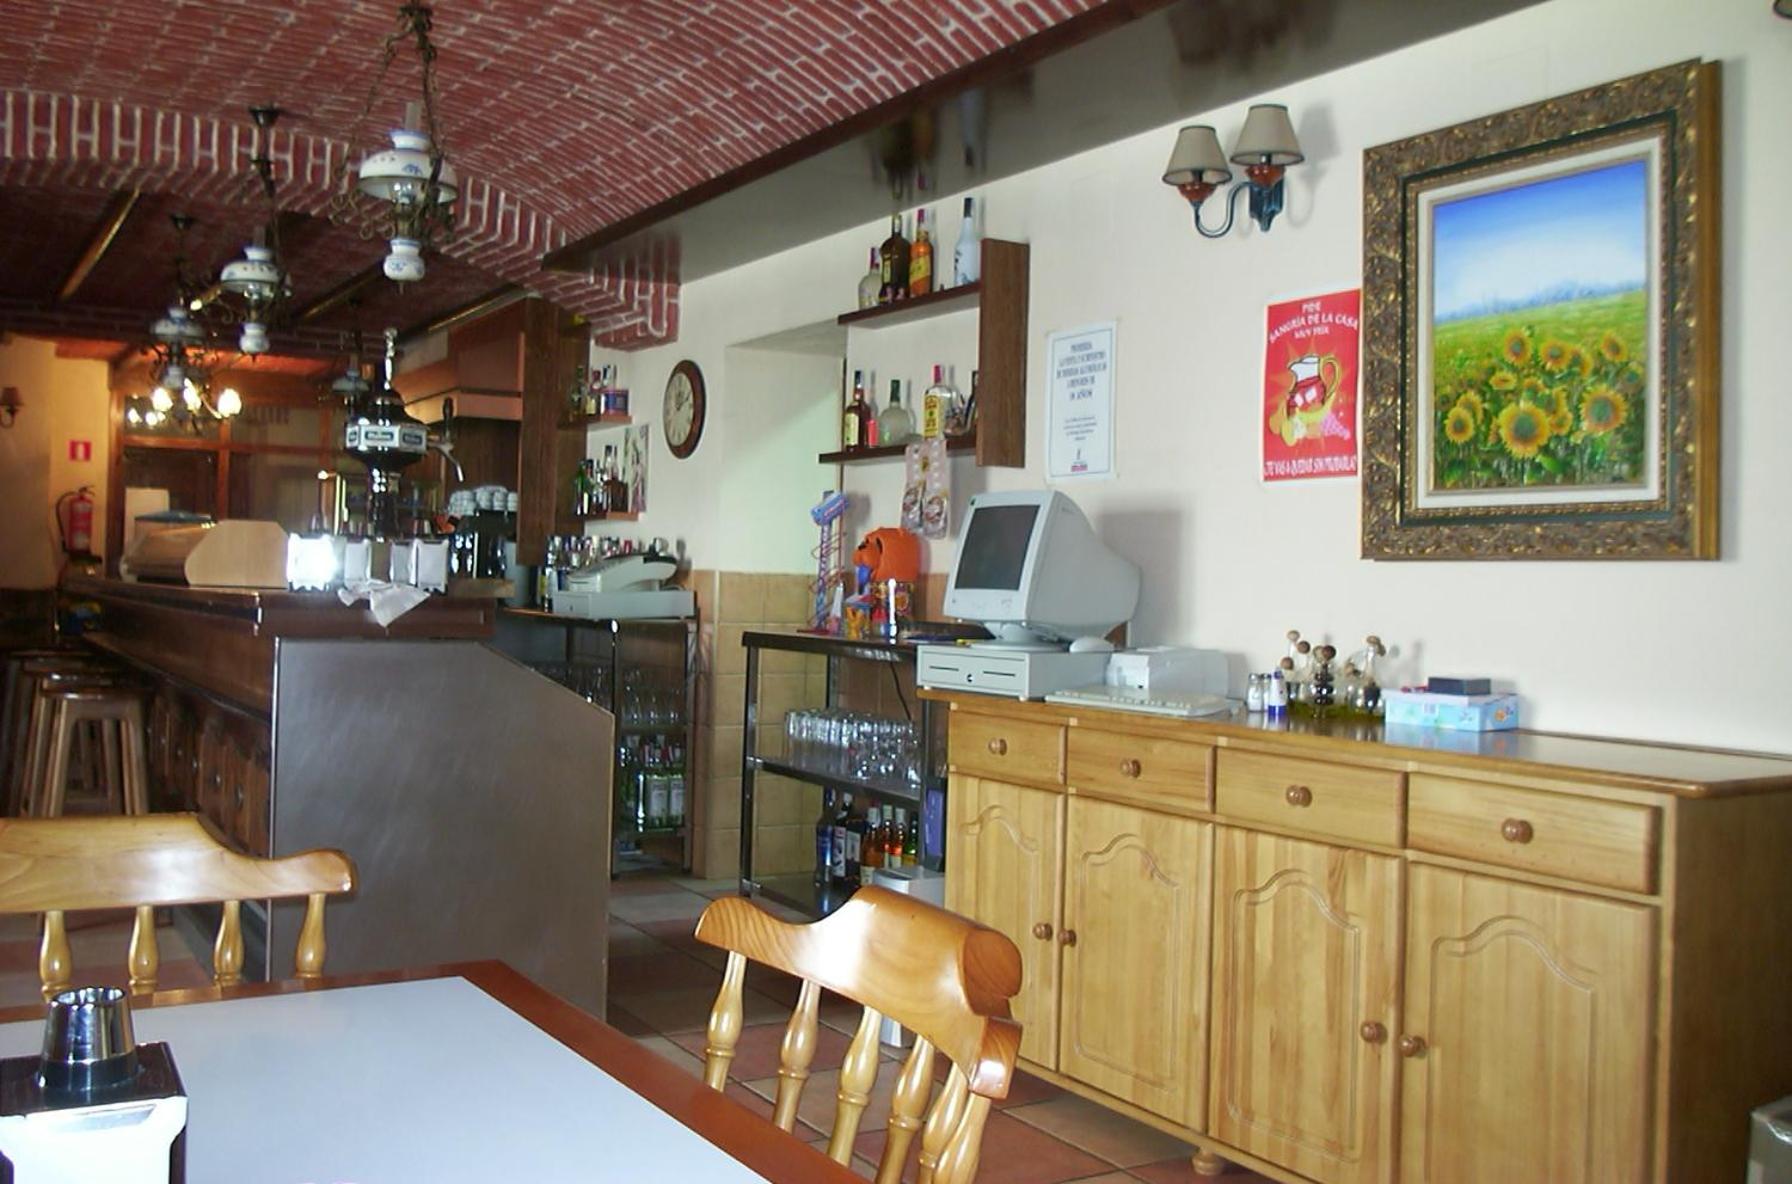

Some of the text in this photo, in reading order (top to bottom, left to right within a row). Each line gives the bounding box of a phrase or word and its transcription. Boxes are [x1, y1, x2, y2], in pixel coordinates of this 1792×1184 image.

[1307, 313, 1320, 325] DE
[1321, 313, 1333, 323] LA
[1335, 314, 1358, 330] CASA
